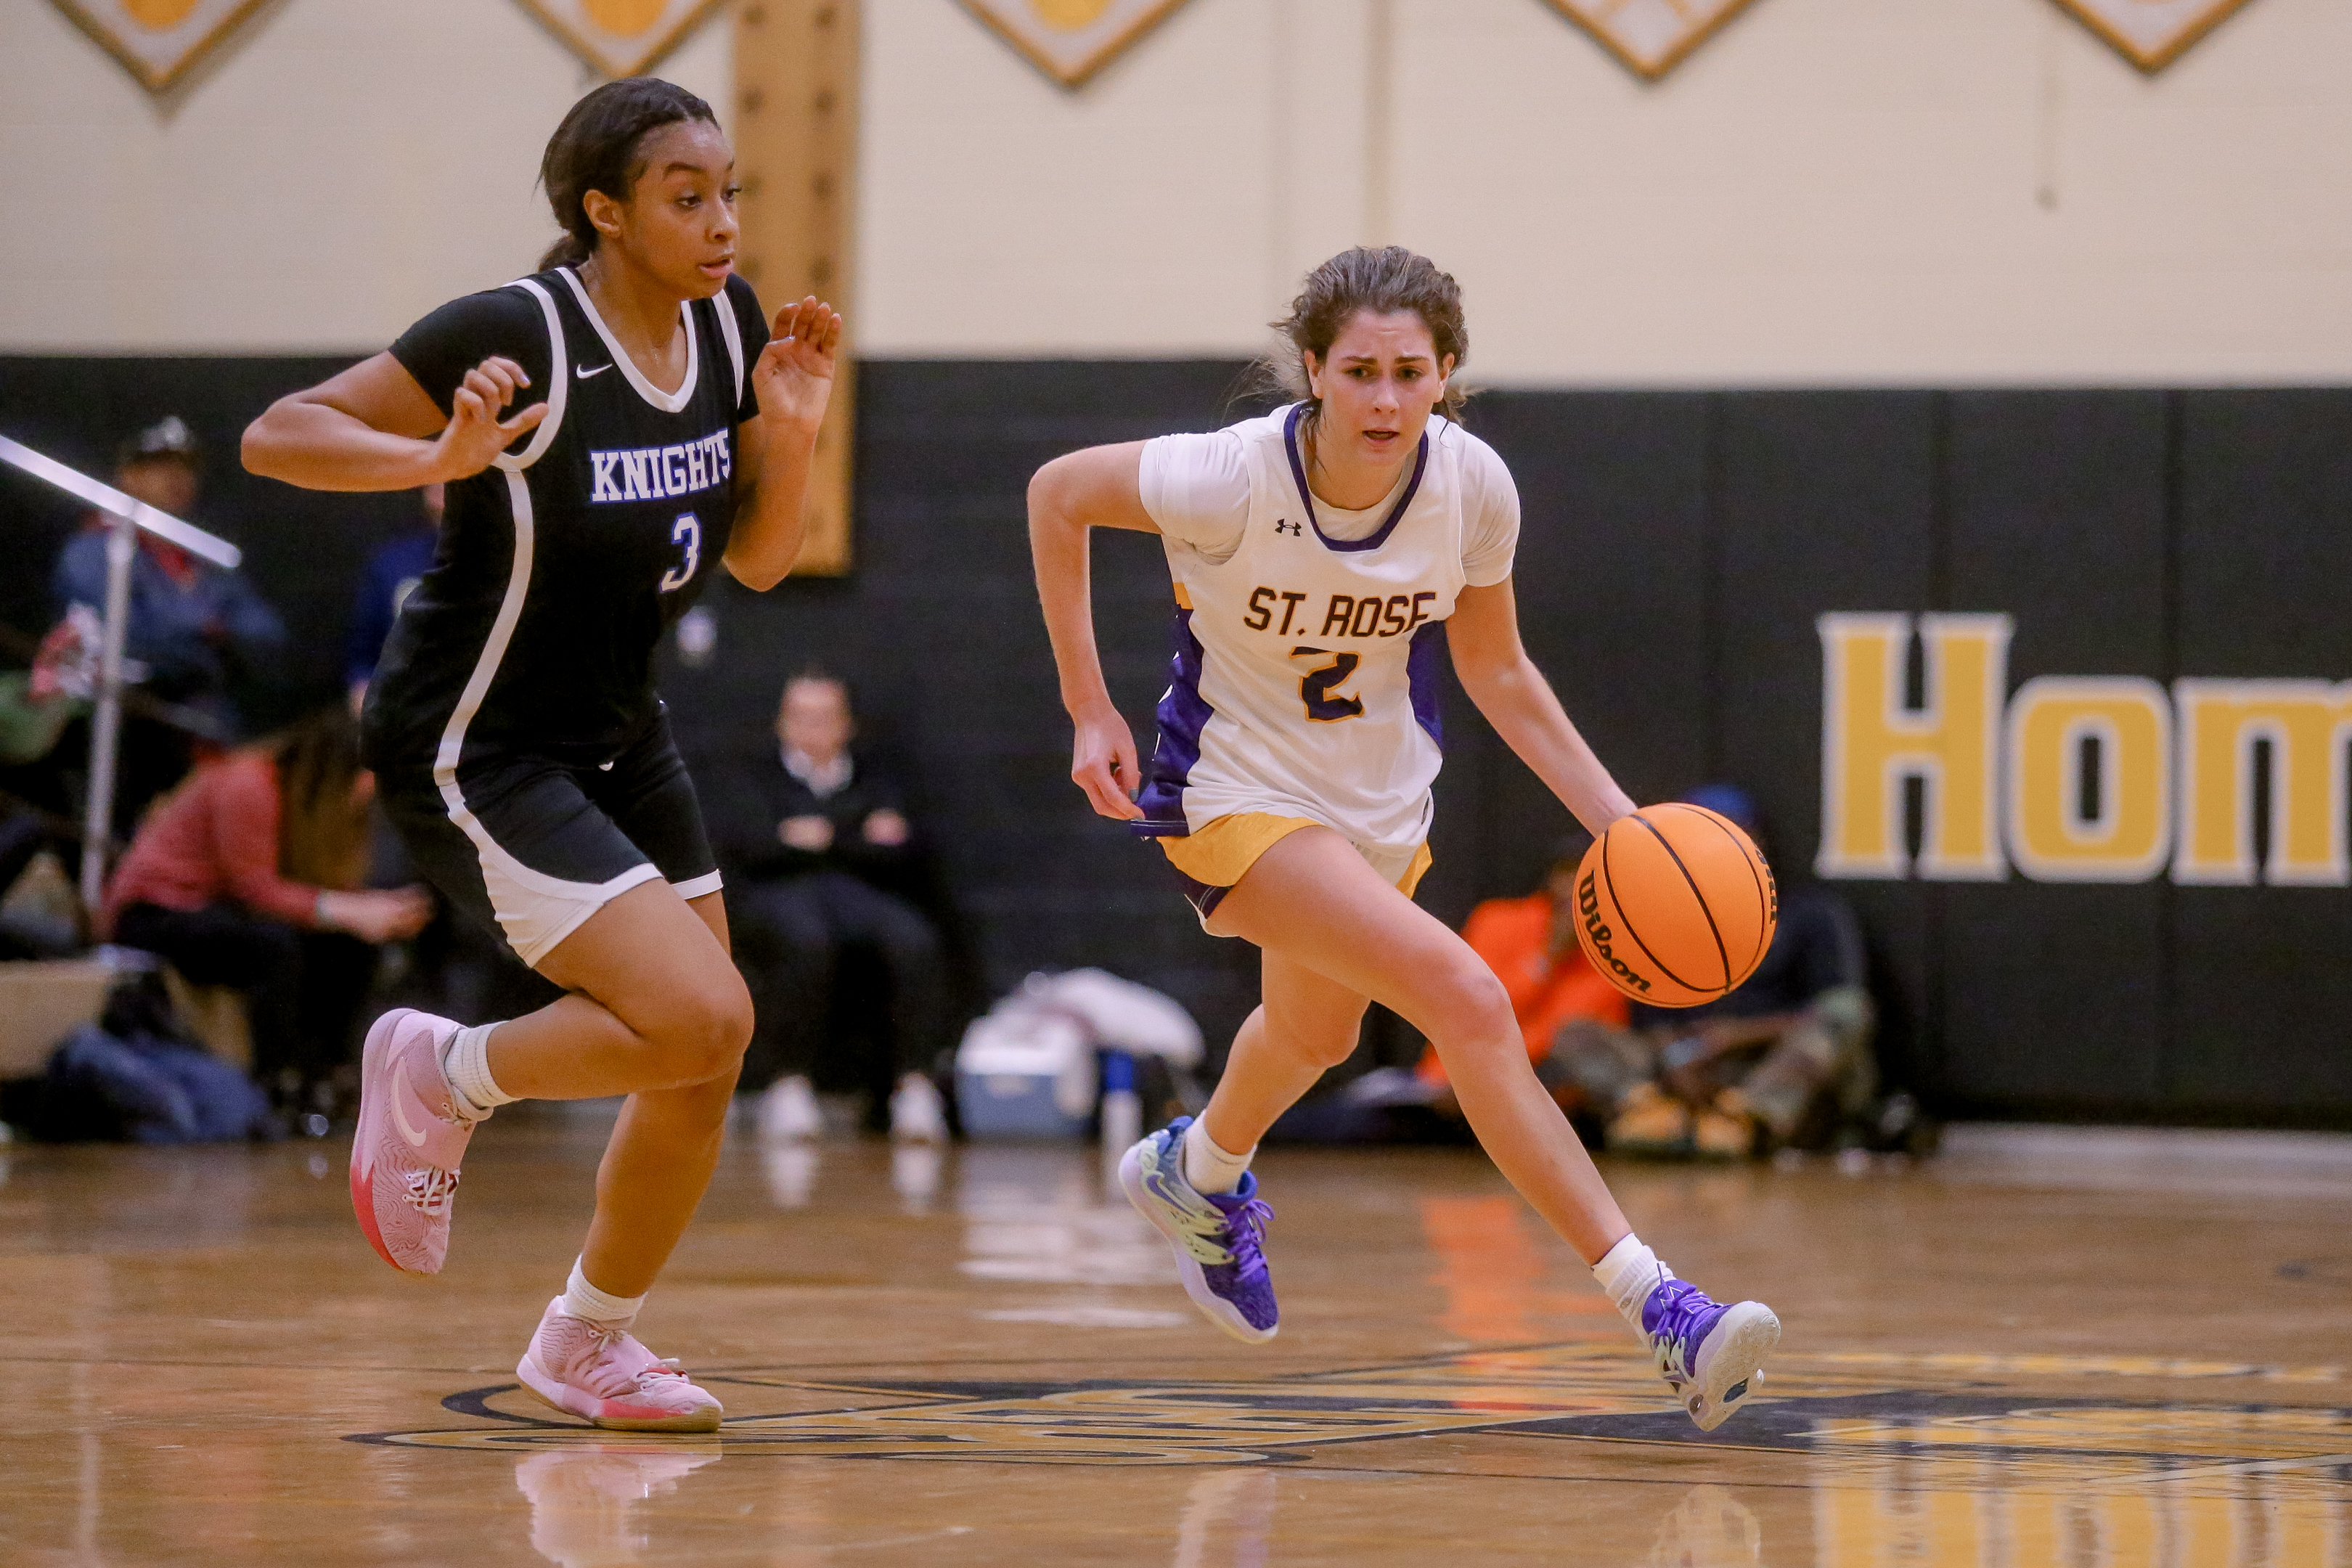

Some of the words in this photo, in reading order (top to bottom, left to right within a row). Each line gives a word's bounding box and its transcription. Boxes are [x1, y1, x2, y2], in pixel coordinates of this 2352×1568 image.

[658, 511, 702, 594] 3
[1243, 585, 1307, 637] ST.
[1289, 645, 1365, 722] 2
[1578, 870, 1651, 993] Wilson
